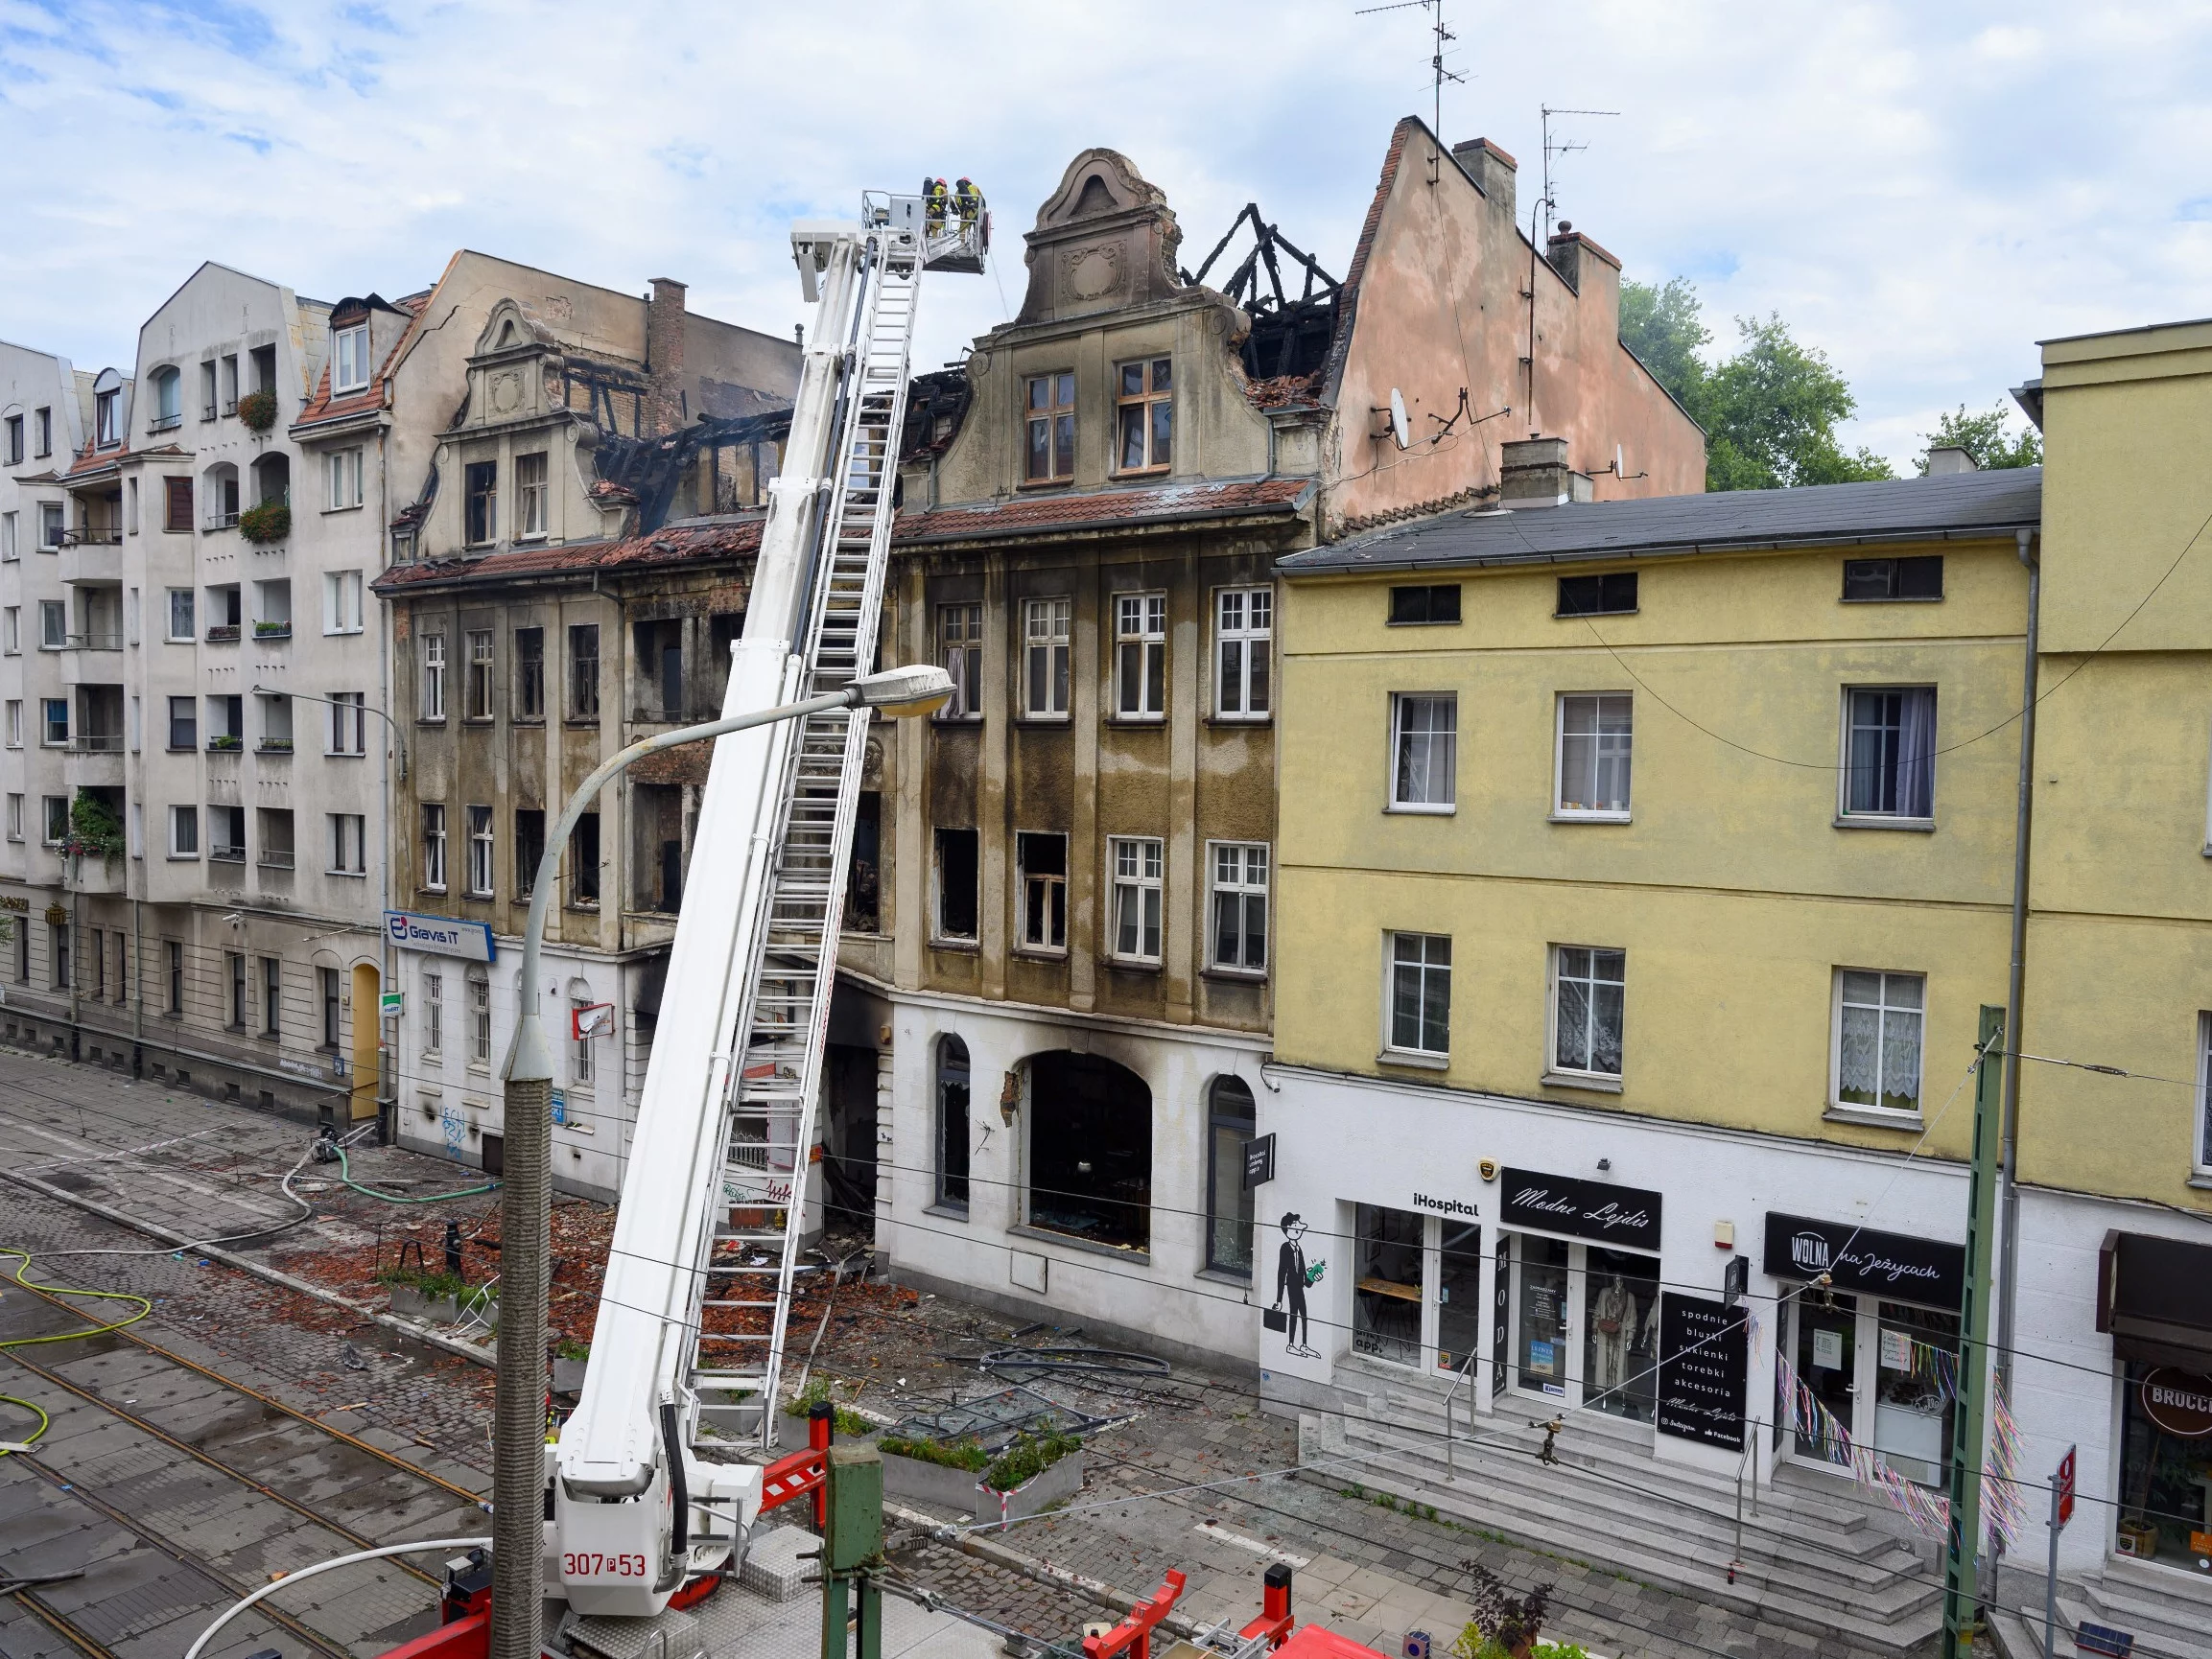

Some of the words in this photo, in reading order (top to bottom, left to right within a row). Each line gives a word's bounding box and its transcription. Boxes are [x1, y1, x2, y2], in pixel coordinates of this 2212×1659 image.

[409, 925, 447, 943] Gravis
[1413, 1193, 1479, 1216] iHospital
[1512, 1187, 1577, 1215] Modne
[1583, 1203, 1650, 1228] Lejdis
[1792, 1237, 1829, 1268] WOLNA
[1840, 1250, 1863, 1265] na
[1859, 1253, 1941, 1281] Jeżycach
[1682, 1310, 1728, 1325] spodnie
[1686, 1326, 1722, 1342] bluzki
[1679, 1344, 1728, 1361] sukienki
[1682, 1362, 1725, 1378] torebki
[1674, 1378, 1730, 1397] akcesoria
[1713, 1431, 1741, 1443] Facebook
